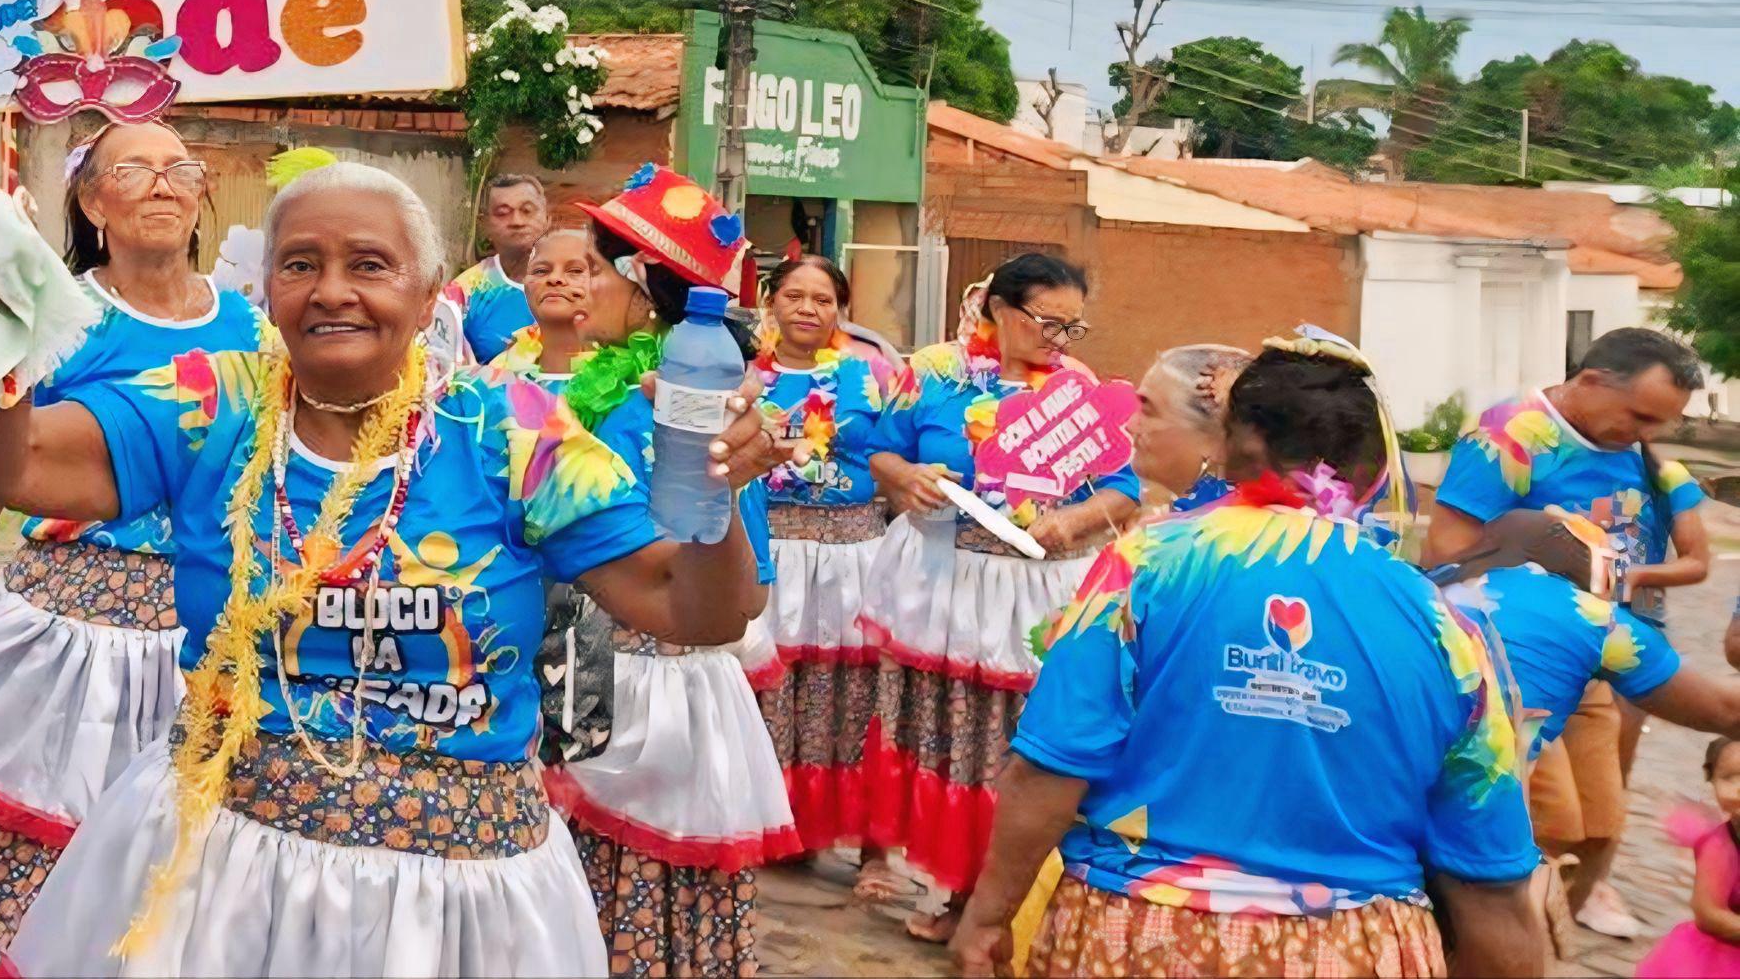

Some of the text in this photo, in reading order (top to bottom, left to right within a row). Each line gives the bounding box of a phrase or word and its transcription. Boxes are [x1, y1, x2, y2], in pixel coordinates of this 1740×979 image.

[703, 66, 862, 140] FIGO LEO
[317, 587, 439, 631] BLOCO
